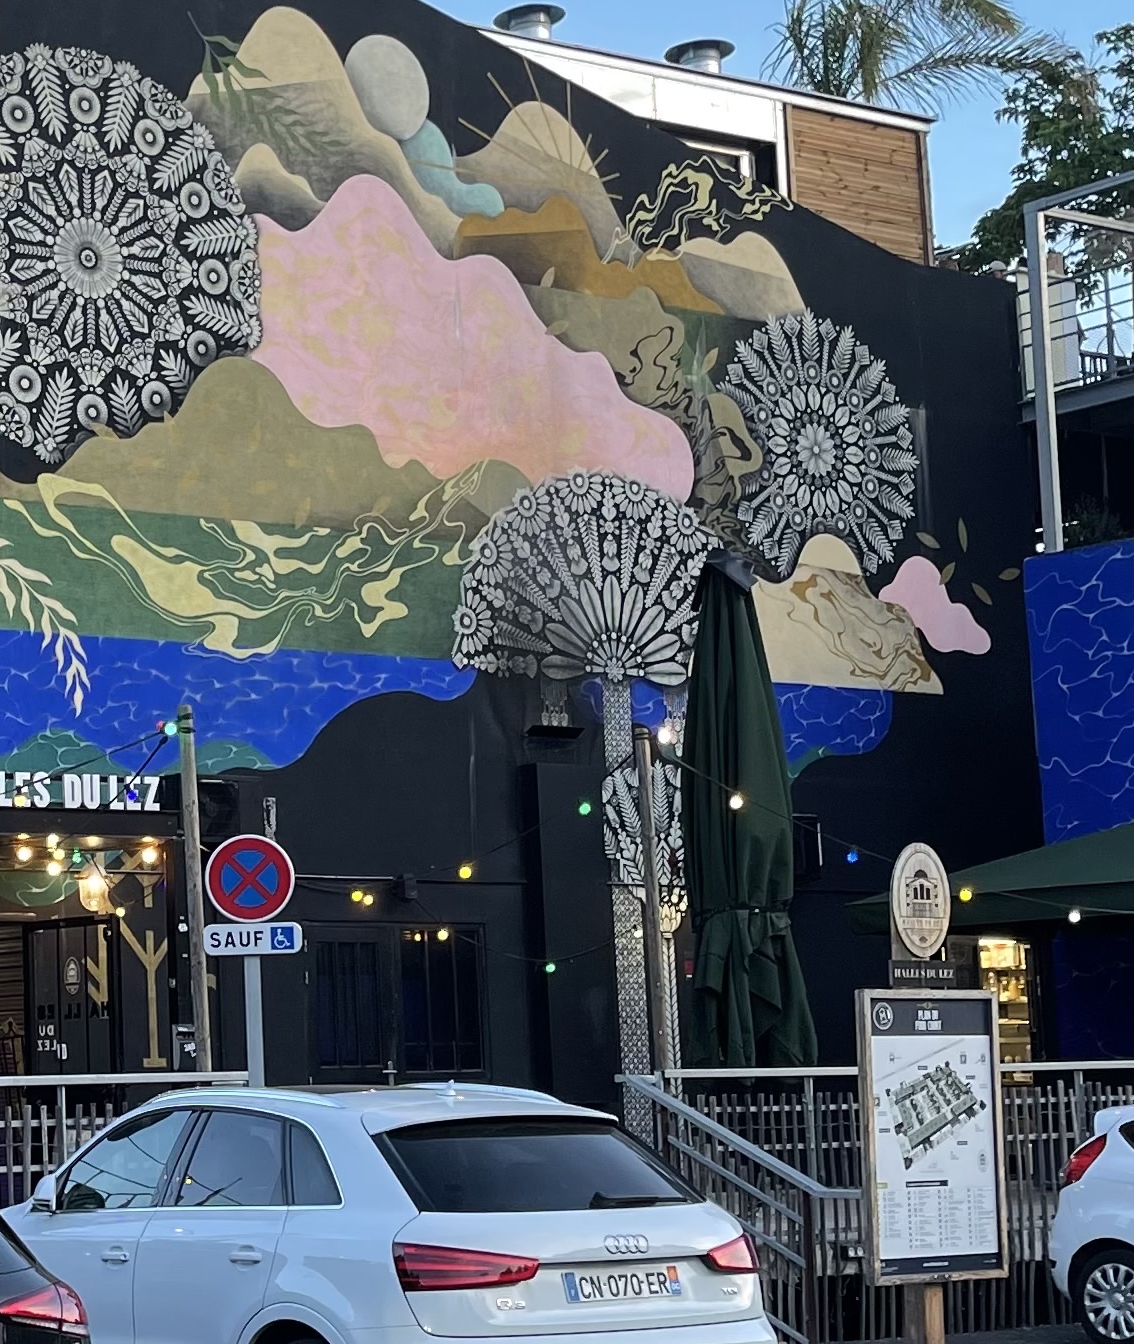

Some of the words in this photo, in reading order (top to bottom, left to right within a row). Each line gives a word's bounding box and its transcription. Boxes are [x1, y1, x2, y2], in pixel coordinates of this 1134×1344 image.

[62, 773, 101, 810] DU
[108, 774, 161, 812] LEZ
[210, 931, 264, 948] SAUF
[578, 1272, 671, 1300] CN-070-ER
